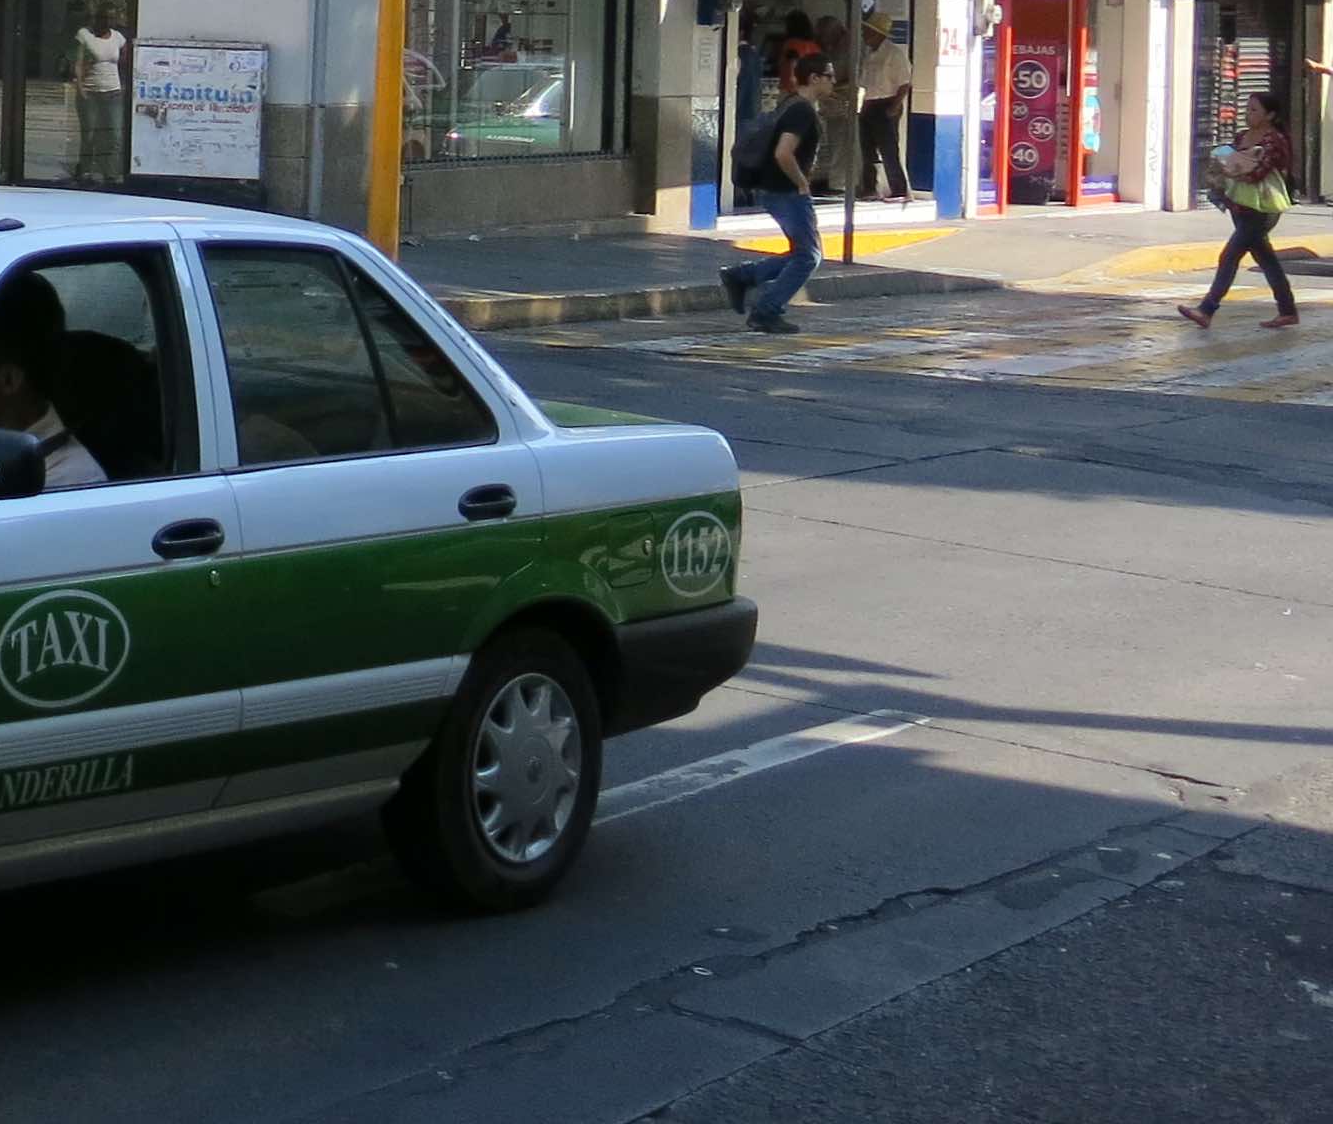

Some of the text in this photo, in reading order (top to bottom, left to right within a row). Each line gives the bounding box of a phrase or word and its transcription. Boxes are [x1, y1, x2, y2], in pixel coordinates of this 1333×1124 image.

[1012, 44, 1055, 55] EBAJAS
[669, 526, 722, 578] 1152
[11, 610, 111, 684] TAXI
